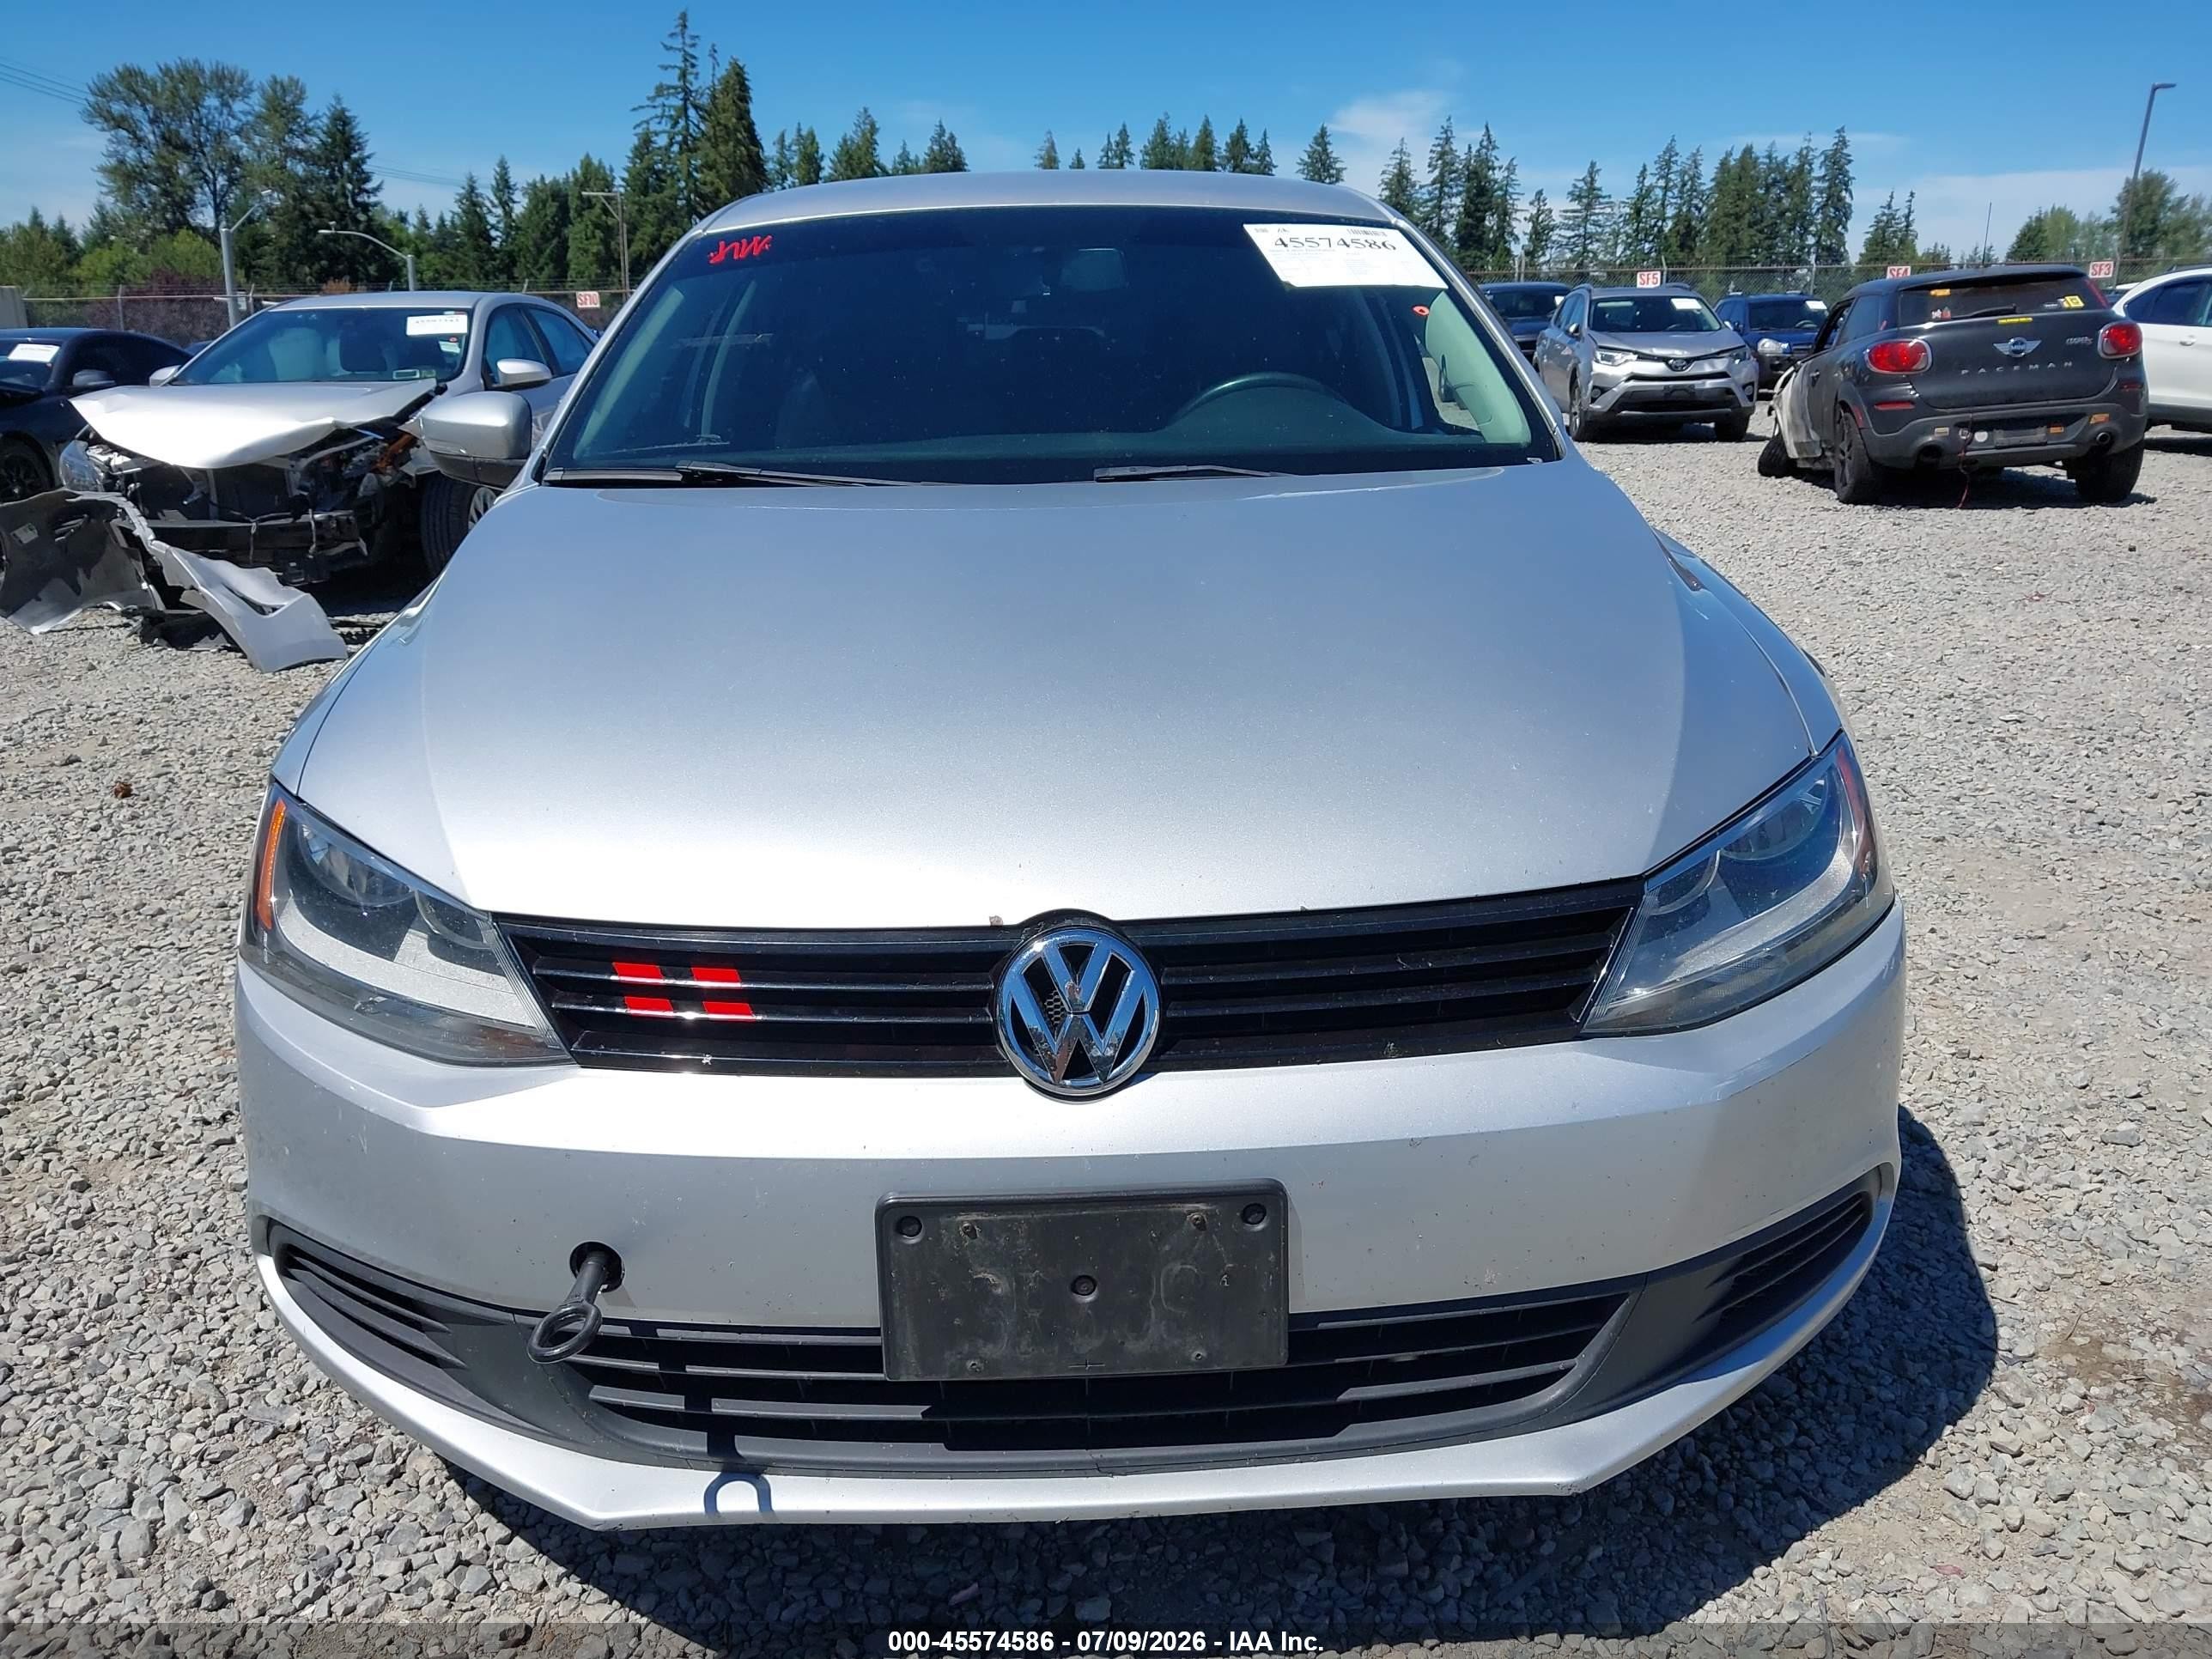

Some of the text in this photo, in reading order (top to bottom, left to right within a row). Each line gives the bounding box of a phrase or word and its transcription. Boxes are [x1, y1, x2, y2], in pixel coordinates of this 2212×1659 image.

[1274, 237, 1397, 251] 45574586
[2091, 263, 2112, 276] SF3
[1639, 273, 1658, 285] SF5
[578, 293, 598, 306] SF10
[1961, 362, 2073, 375] PACEMAN
